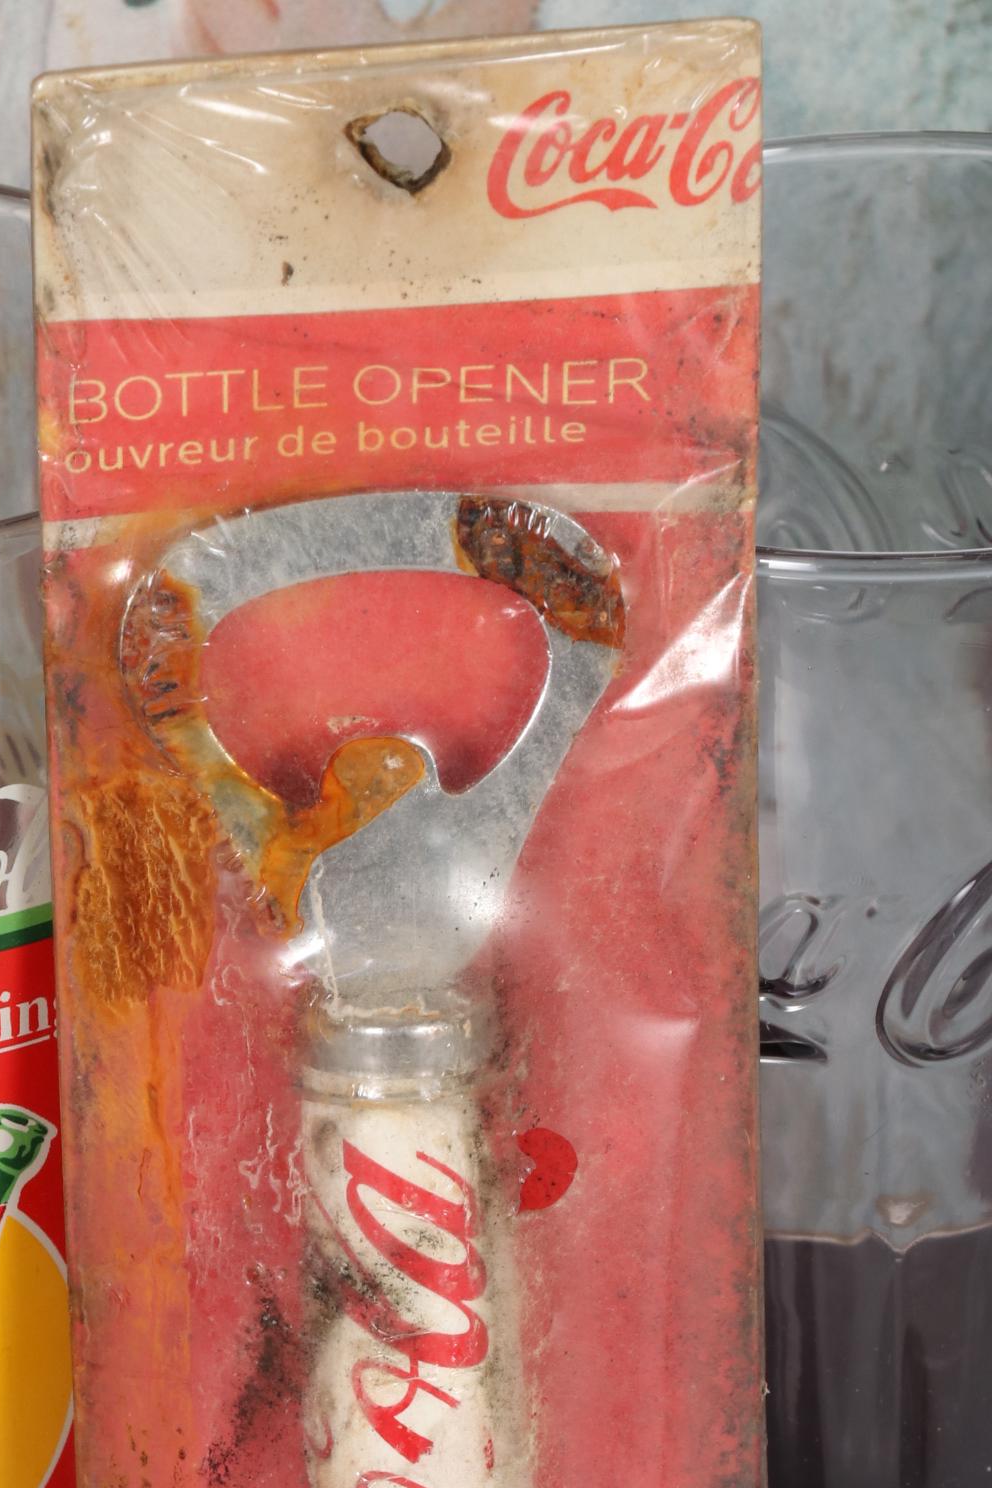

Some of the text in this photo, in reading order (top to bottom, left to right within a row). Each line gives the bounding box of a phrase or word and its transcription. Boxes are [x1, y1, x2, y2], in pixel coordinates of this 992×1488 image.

[68, 356, 652, 426] BOTTLE OPENER
[64, 413, 587, 475] ouvreur de bouteille
